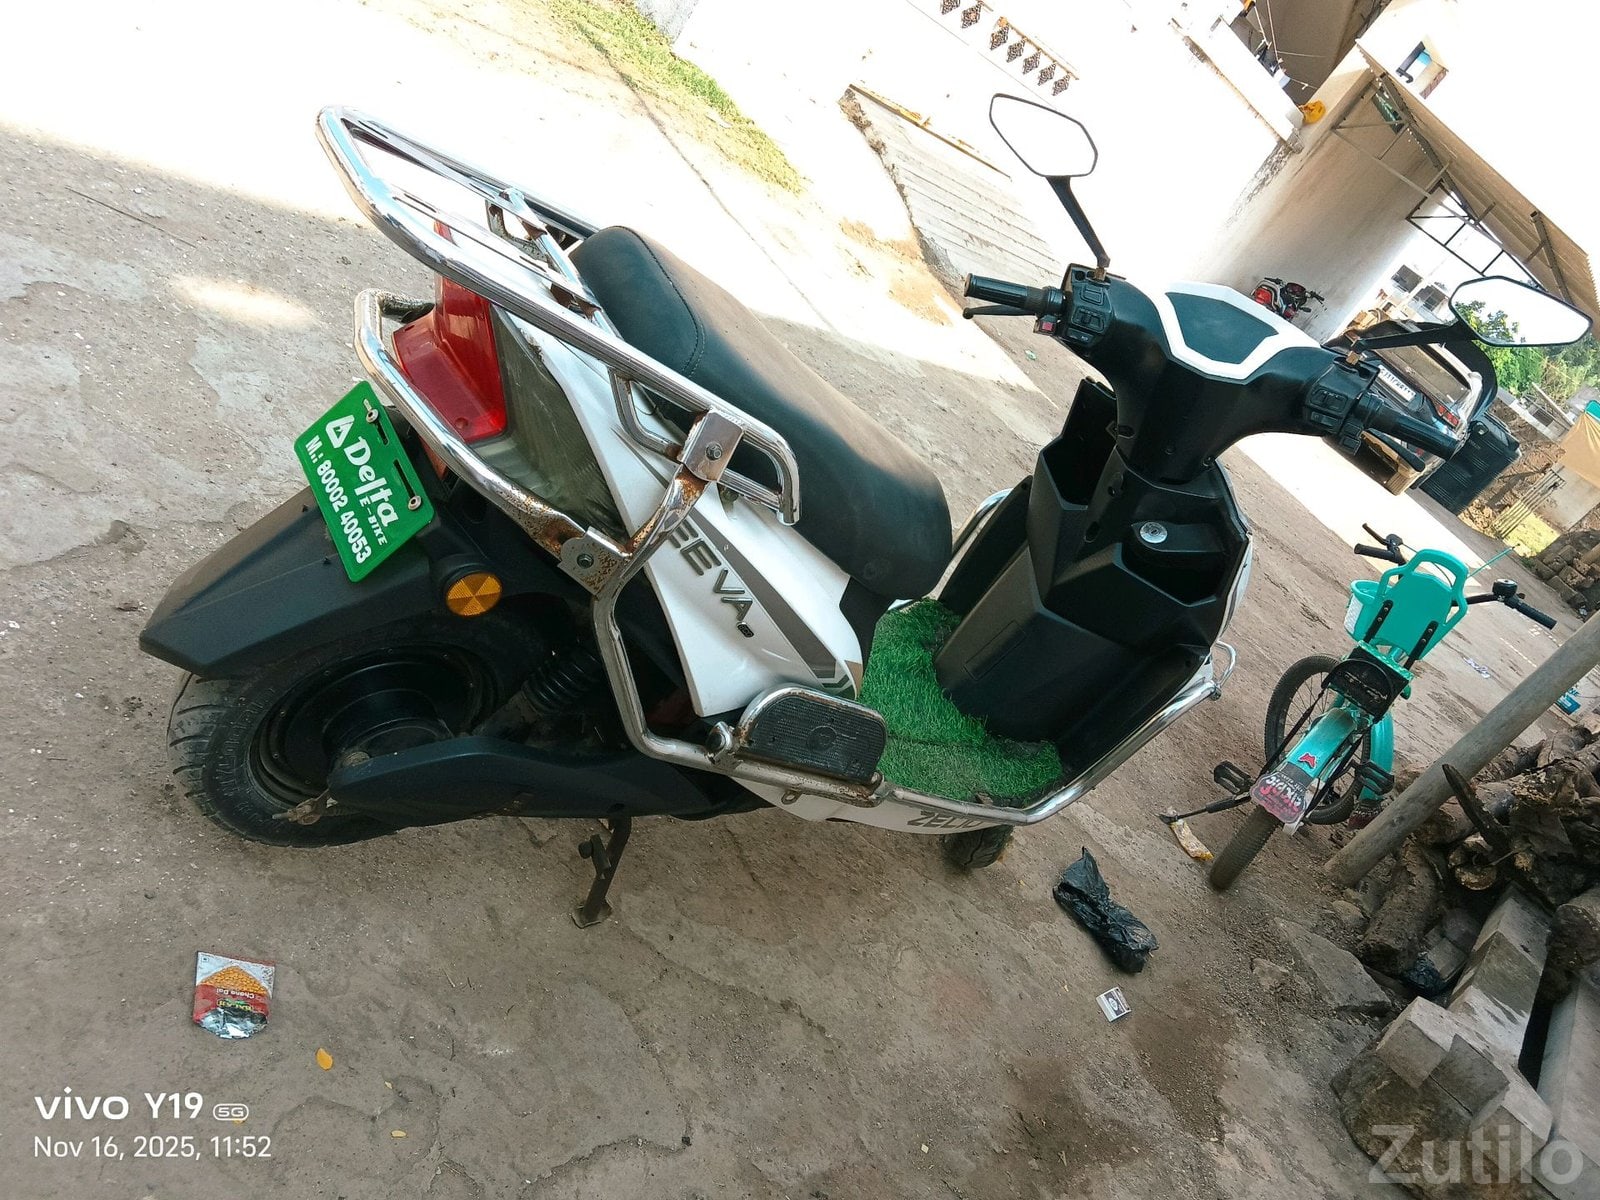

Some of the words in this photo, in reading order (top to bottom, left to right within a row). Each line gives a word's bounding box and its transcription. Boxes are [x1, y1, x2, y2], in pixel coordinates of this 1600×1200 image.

[316, 459, 349, 513] 80002
[340, 510, 372, 564] 40053
[344, 436, 399, 527] Delta
